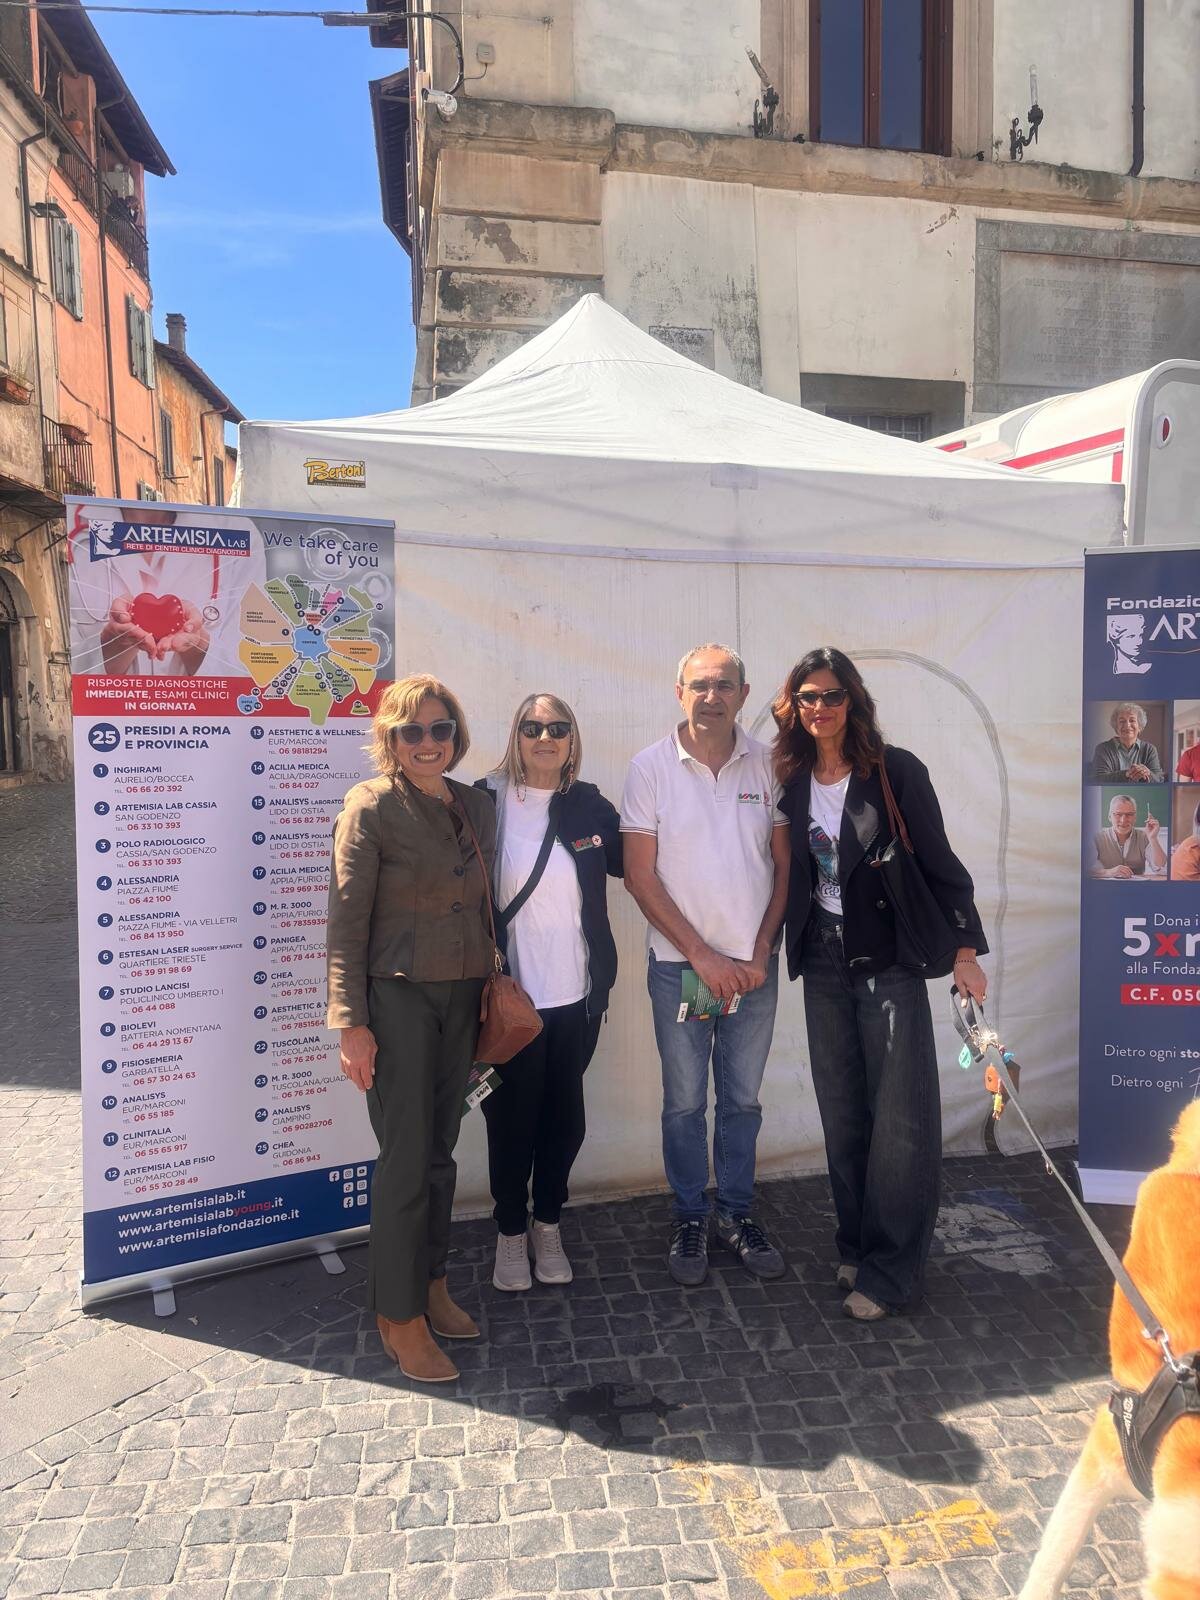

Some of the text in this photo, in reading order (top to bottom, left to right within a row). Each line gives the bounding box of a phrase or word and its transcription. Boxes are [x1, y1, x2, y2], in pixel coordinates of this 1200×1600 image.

[303, 460, 365, 482] Bertoni
[123, 526, 224, 546] ARTEMISIA
[264, 532, 378, 552] We take care
[325, 551, 379, 568] of you
[88, 679, 228, 688] RISPOSTE DIAGNOSTICHE
[86, 690, 229, 699] IMMEDIATE, ESAMI CLINICI
[125, 702, 196, 710] IN GIORNATA
[125, 726, 231, 735] PRESIDI A ROMA
[92, 730, 117, 744] 25
[125, 740, 209, 749] E PROVINCIA
[114, 776, 194, 784] AURELIO/BOCCEA
[269, 772, 360, 780] ACILIA/DRAGONCELLO
[269, 798, 309, 806] ANALISYS
[143, 838, 205, 847] RADIOLOGICO
[116, 847, 217, 858] CASSIA/SAN GODENZO
[101, 879, 107, 887] 4
[117, 875, 179, 885] ALESSANDRIA
[270, 876, 322, 885] APPIA/FURIO
[117, 885, 179, 895] PIAZZA FIUME
[118, 911, 180, 922] ALESSANDRIA
[270, 910, 322, 919] APPIA/FURIO
[1154, 913, 1191, 927] Dona
[119, 917, 238, 932] PIAZZA FIUME VIA VELLETRI
[119, 949, 158, 958] ESTESAN
[119, 954, 206, 969] QUARTIERE TRIESTE
[1126, 961, 1148, 974] alla
[120, 982, 190, 995] STUDIO LANCISI
[271, 978, 321, 988] APPIA/COLLI
[120, 993, 175, 1005] POLICLINICO
[178, 989, 219, 999] UMBERTO
[1130, 988, 1165, 1001] C.F.
[272, 1003, 314, 1013] AESTHETIC
[272, 1012, 321, 1023] APPIA/COLLI
[121, 1022, 156, 1031] BIOLEVI
[121, 1024, 221, 1042] BATTERIA NOMENTANA
[272, 1036, 320, 1048] TUSCOLANA
[1104, 1044, 1146, 1057] Dietro
[1150, 1047, 1176, 1062] ogni
[122, 1055, 183, 1068] FISIOSEMERIA
[122, 1065, 180, 1078] GARBATELLA
[292, 1071, 312, 1079] 3000
[1111, 1074, 1152, 1088] Dietro
[1156, 1077, 1183, 1092] ogni
[122, 1092, 166, 1104] ANALISYS
[123, 1099, 186, 1114] EUR/MARCONI
[272, 1105, 311, 1116] ANALISYS
[272, 1113, 311, 1126] CIAMPINO
[123, 1128, 172, 1140] CLINITALIA
[123, 1134, 187, 1151] EUR/MARCONI
[273, 1141, 294, 1150] CHEA
[273, 1147, 311, 1159] GUIDONIA
[124, 1155, 215, 1177] ARTEMISIA LAB FISIO
[124, 1169, 187, 1186] EUR/MARCONI
[118, 1189, 246, 1223] www.artemisialab.it
[118, 1196, 284, 1238] www.artemisialabyoung.it
[118, 1209, 300, 1254] www.artemisiafondazione.it
